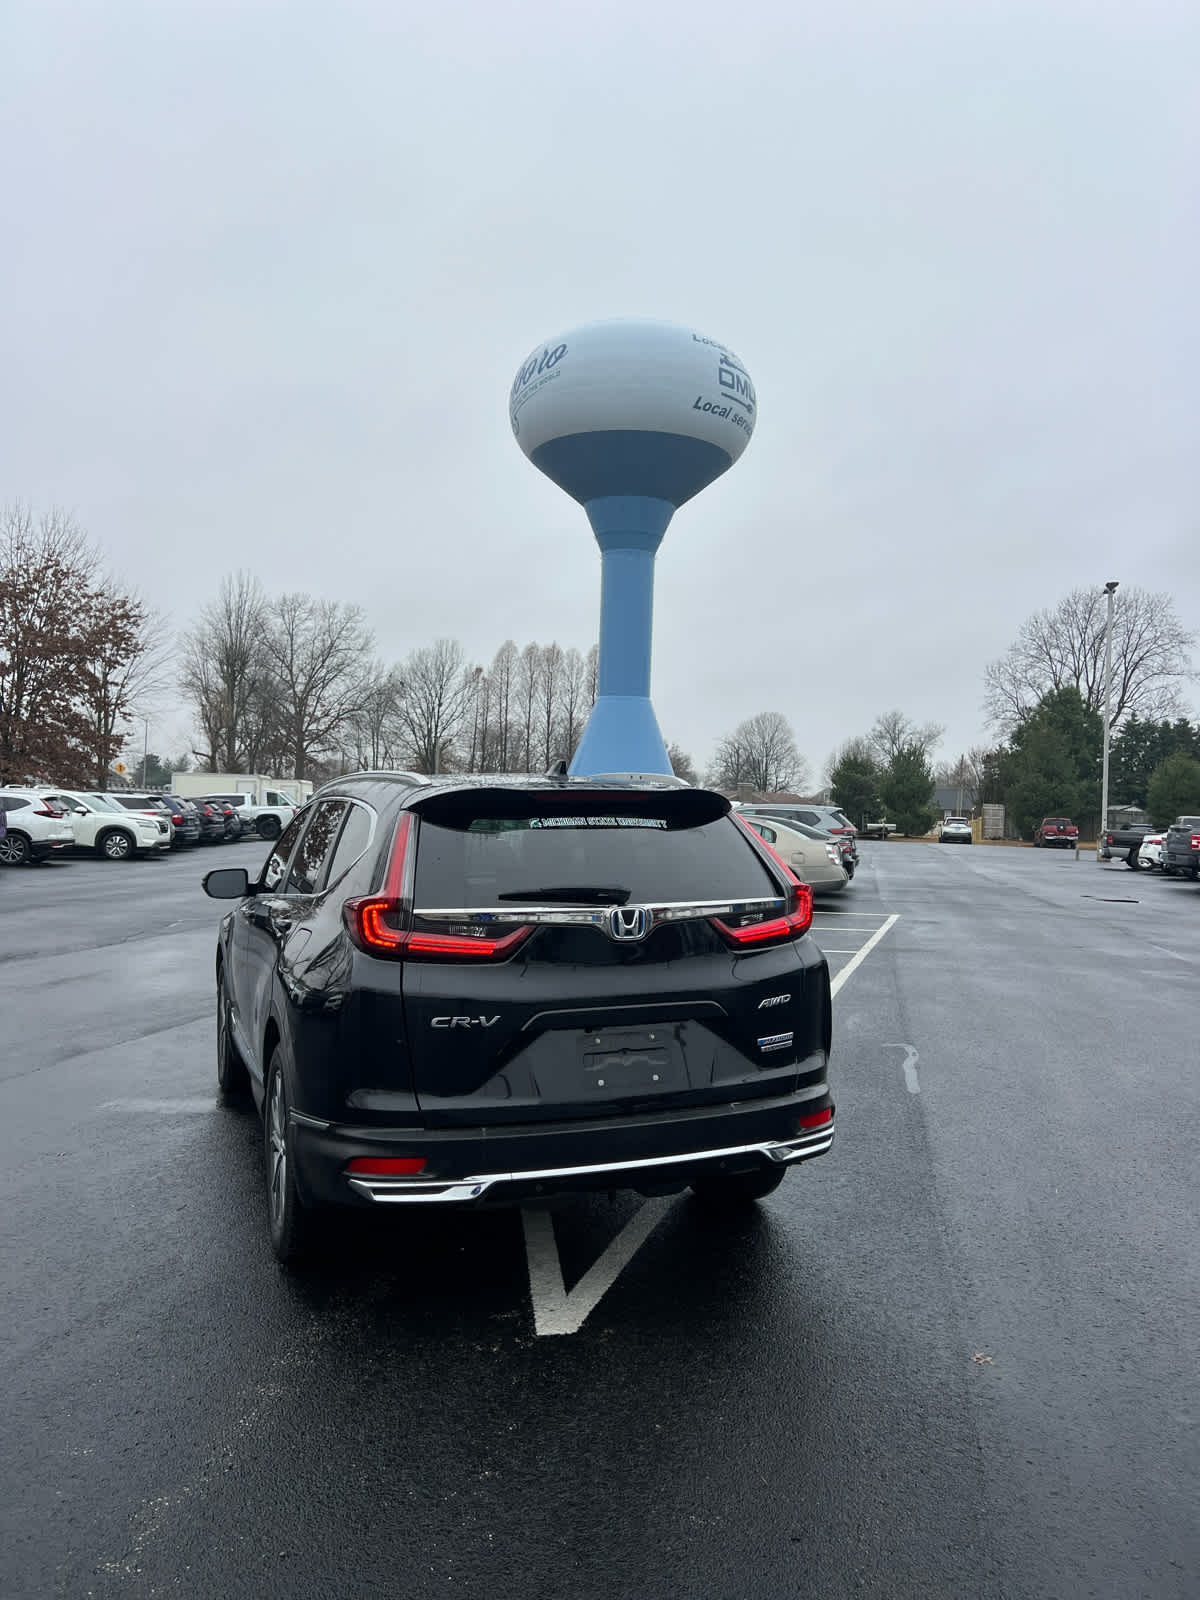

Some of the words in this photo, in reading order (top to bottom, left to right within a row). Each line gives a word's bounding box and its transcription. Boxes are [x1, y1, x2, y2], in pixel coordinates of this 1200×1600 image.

[692, 395, 733, 420] Local
[757, 993, 792, 1009] AWD
[431, 1015, 502, 1029] CR-V
